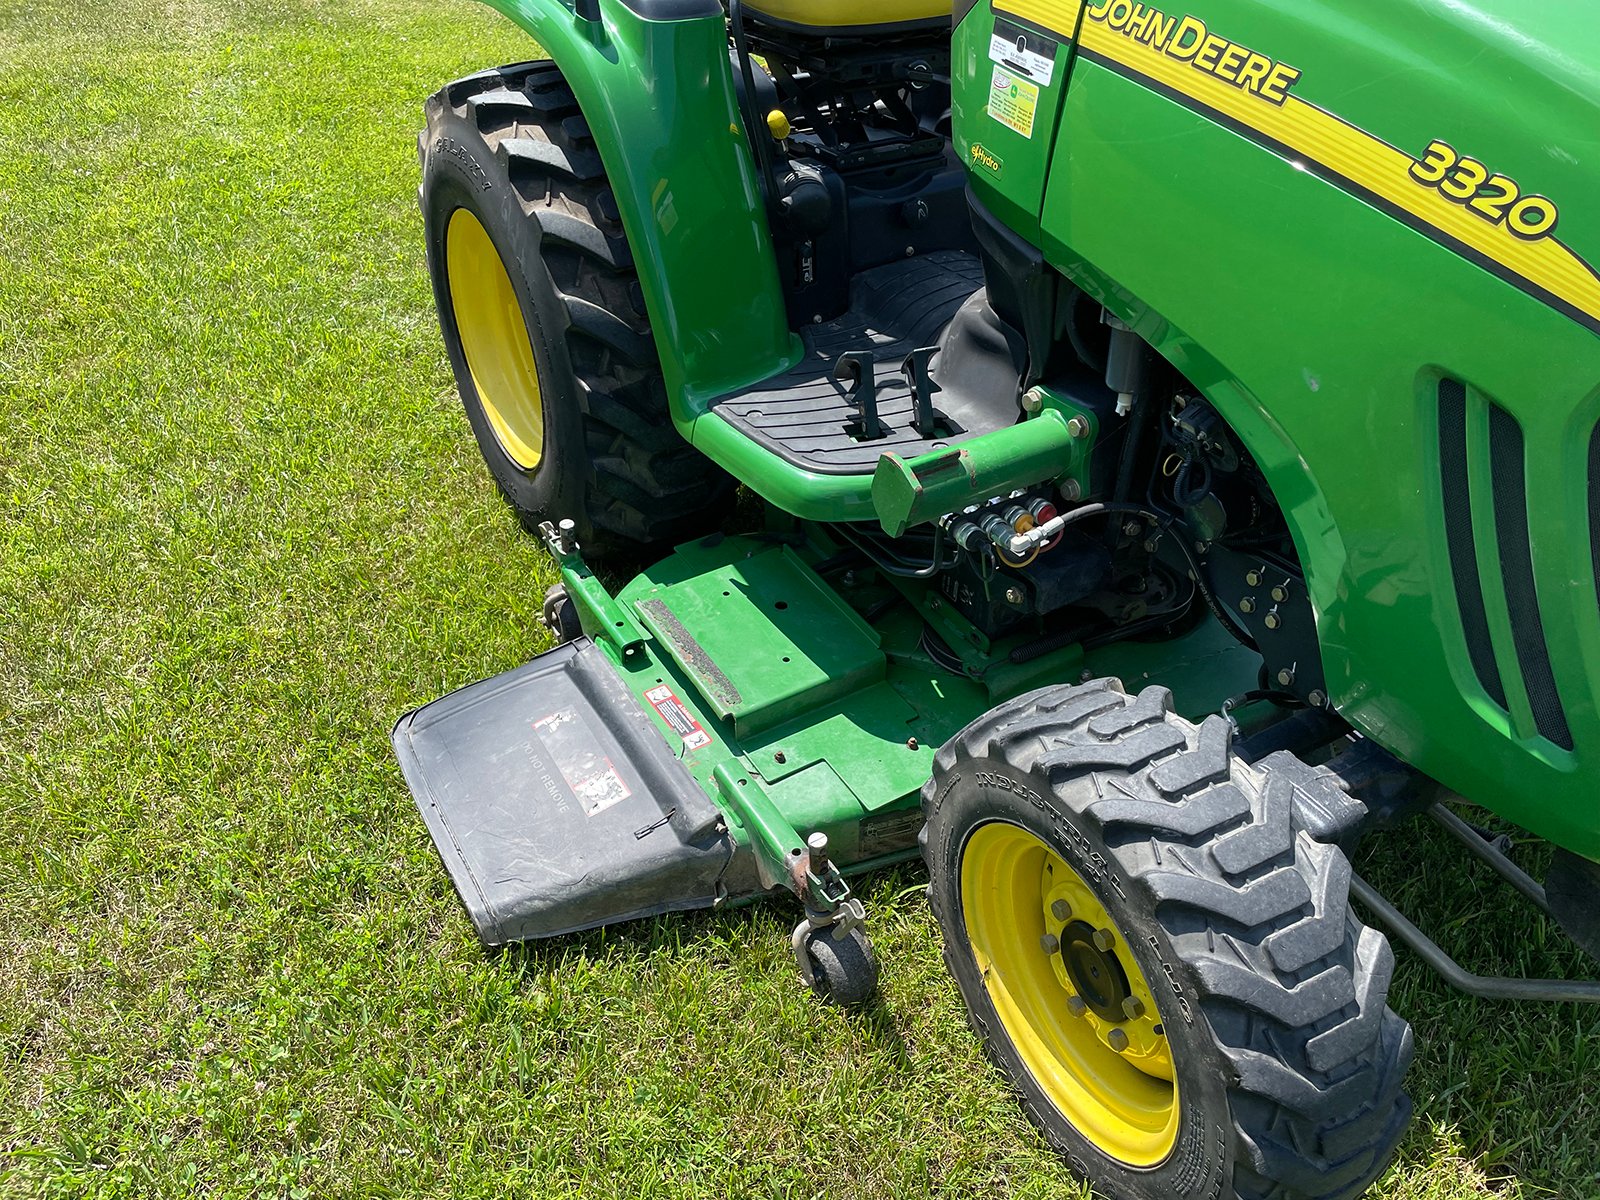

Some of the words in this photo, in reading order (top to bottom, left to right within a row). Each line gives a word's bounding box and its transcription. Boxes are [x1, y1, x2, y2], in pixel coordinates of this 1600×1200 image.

[1089, 0, 1177, 51] JOHN
[1166, 15, 1302, 106] DEERE
[1408, 139, 1559, 240] 3320
[521, 742, 534, 754] DO
[529, 754, 546, 773] NOT
[541, 774, 570, 813] REMOVE
[975, 771, 1127, 900] INDUSTRIAL
